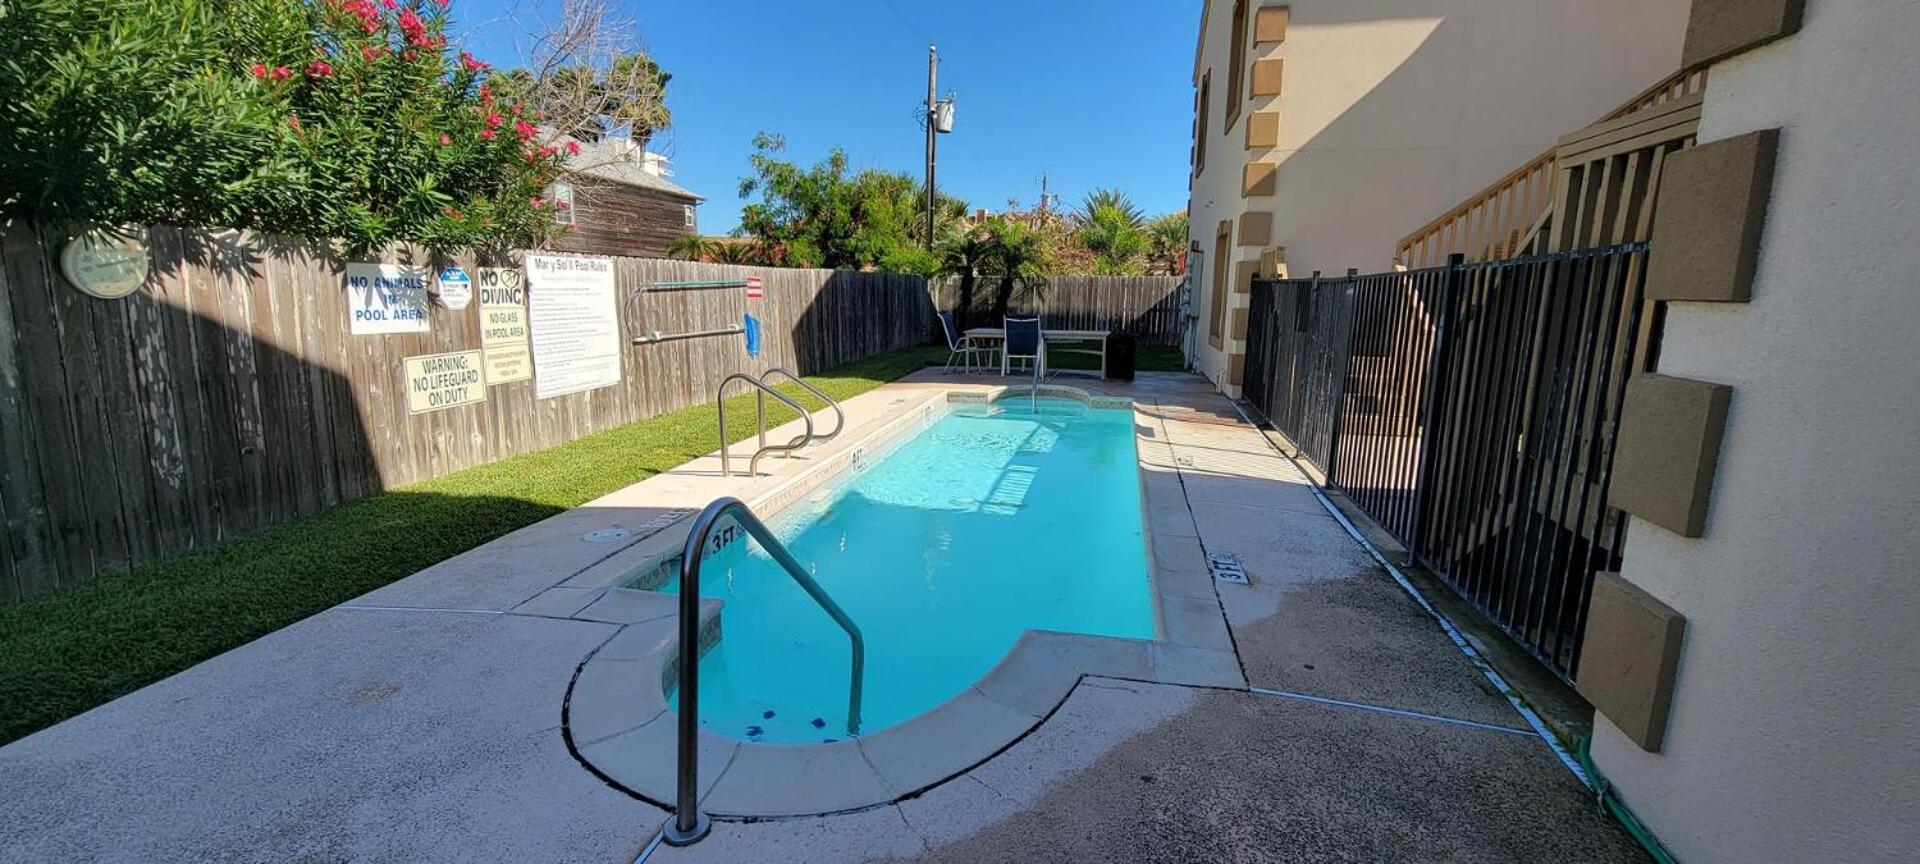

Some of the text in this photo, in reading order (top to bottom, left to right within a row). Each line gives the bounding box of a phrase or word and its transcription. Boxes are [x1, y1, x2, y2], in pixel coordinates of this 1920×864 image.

[534, 257, 549, 270] Mar
[575, 259, 590, 271] Pool
[590, 260, 608, 273] Rules
[350, 276, 424, 289] NO ANIMALS
[480, 270, 498, 287] NO
[384, 293, 398, 304] IN
[481, 288, 522, 305] DIVING
[356, 308, 424, 321] POOL AREA
[490, 312, 518, 324] NO GLASS
[485, 327, 524, 339] IN POOL AREA
[422, 355, 468, 374] WARNING:
[413, 376, 428, 392] NO
[430, 369, 478, 390] LIFEGUARD
[428, 386, 468, 406] ON DUTY
[712, 525, 735, 554] 3 FT
[1212, 560, 1241, 572] FT
